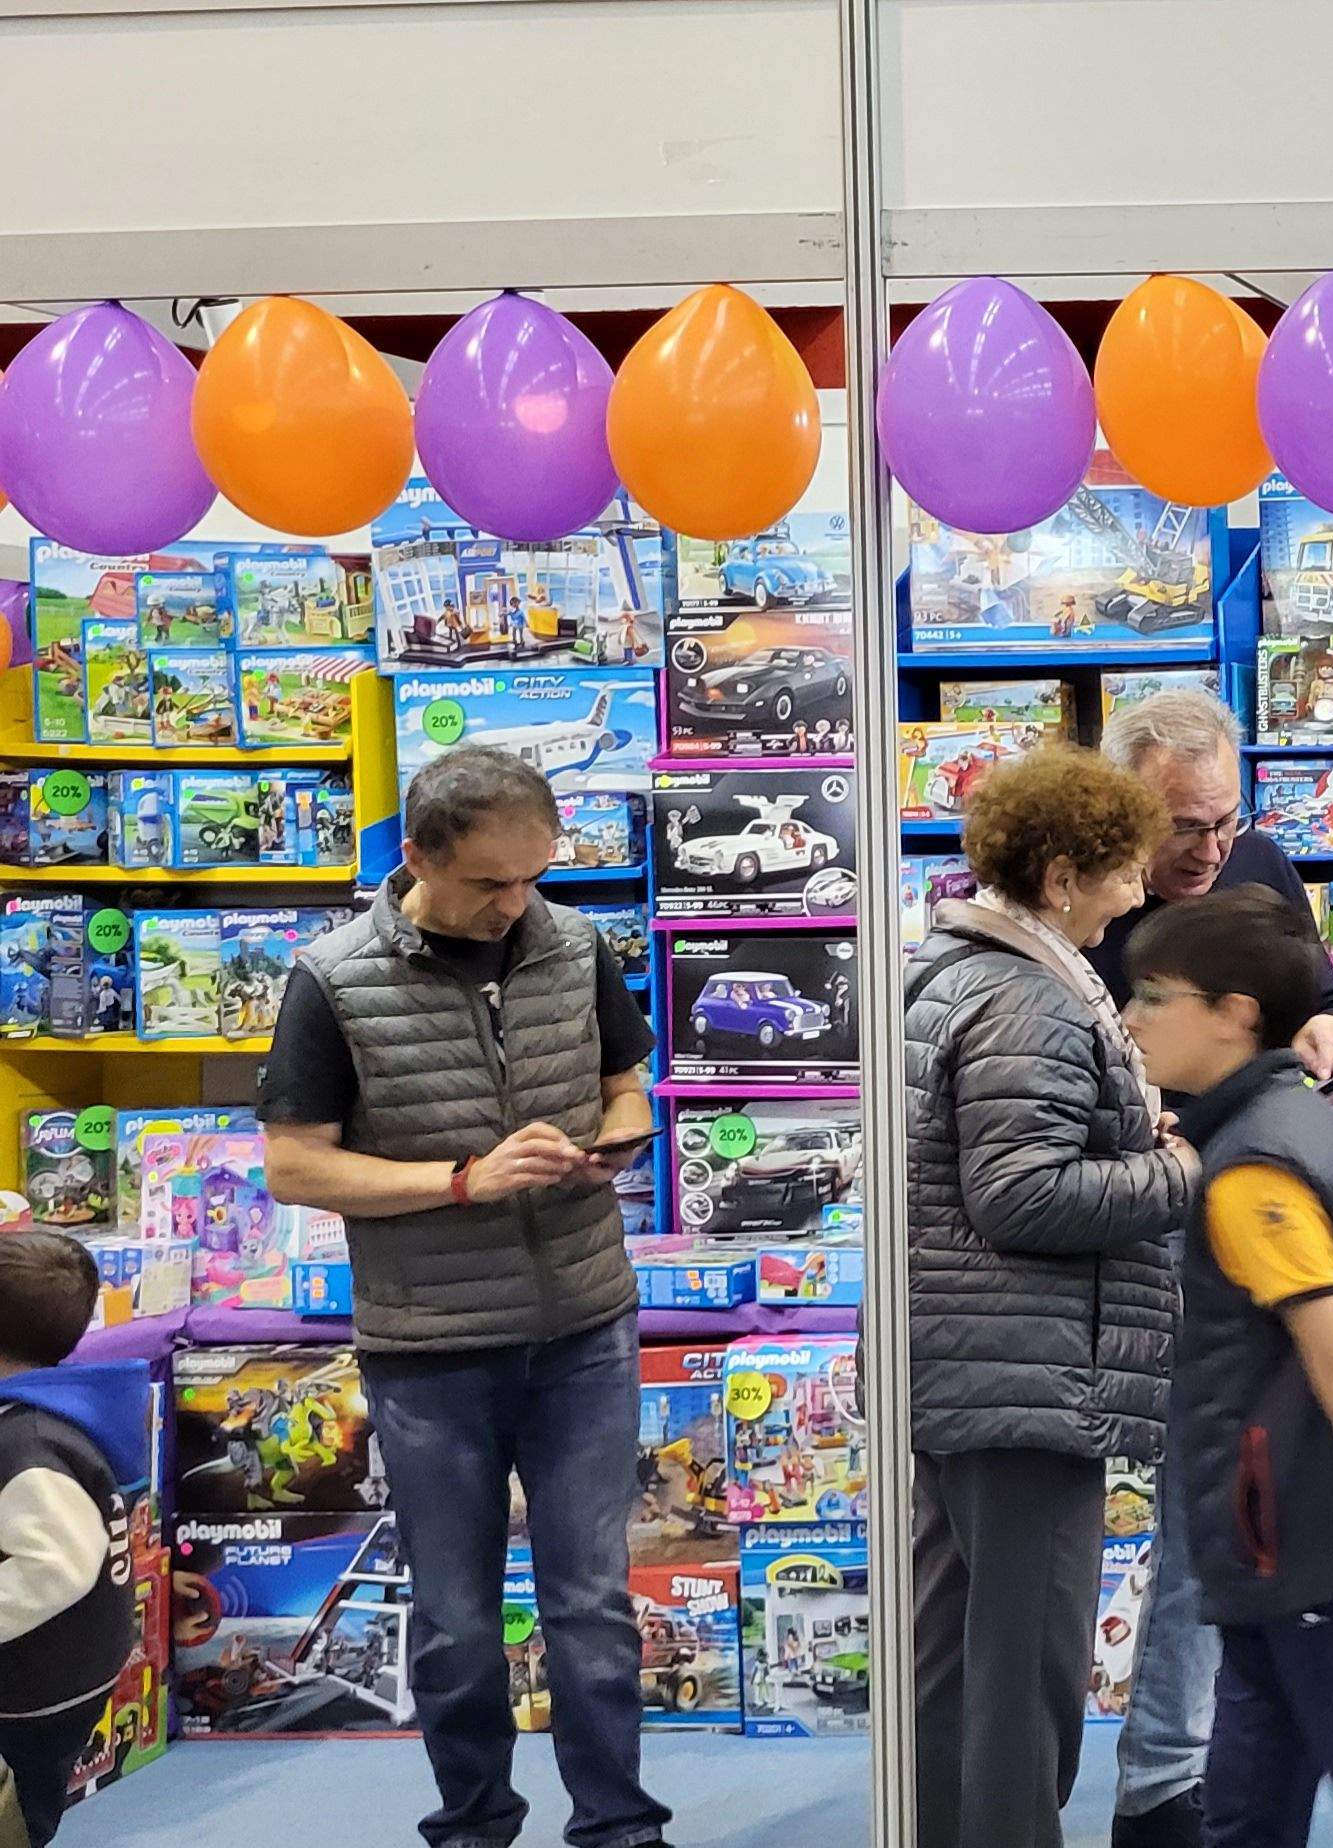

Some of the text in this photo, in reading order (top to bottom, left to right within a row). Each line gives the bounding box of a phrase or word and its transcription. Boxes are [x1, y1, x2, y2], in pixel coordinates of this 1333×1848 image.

[90, 562, 148, 571] Country
[237, 559, 306, 573] playmobil
[669, 616, 723, 630] playmobil
[929, 612, 942, 621] PC
[512, 676, 565, 690] CITY
[399, 679, 495, 702] playmobil
[519, 689, 573, 700] ACTION
[431, 714, 458, 730] 20%
[52, 785, 82, 799] 20%
[223, 911, 297, 928] playmobil
[95, 922, 122, 937] 20%
[719, 1128, 748, 1144] 20%
[177, 1358, 236, 1371] playmobil
[728, 1351, 811, 1370] playmobil
[730, 1387, 763, 1401] 30%
[176, 1519, 282, 1544] playmobil
[745, 1524, 850, 1548] playmobil
[224, 1545, 293, 1556] FUTURE
[225, 1555, 292, 1566] PLANET
[671, 1575, 724, 1598] STUNT
[686, 1592, 729, 1616] SHOW
